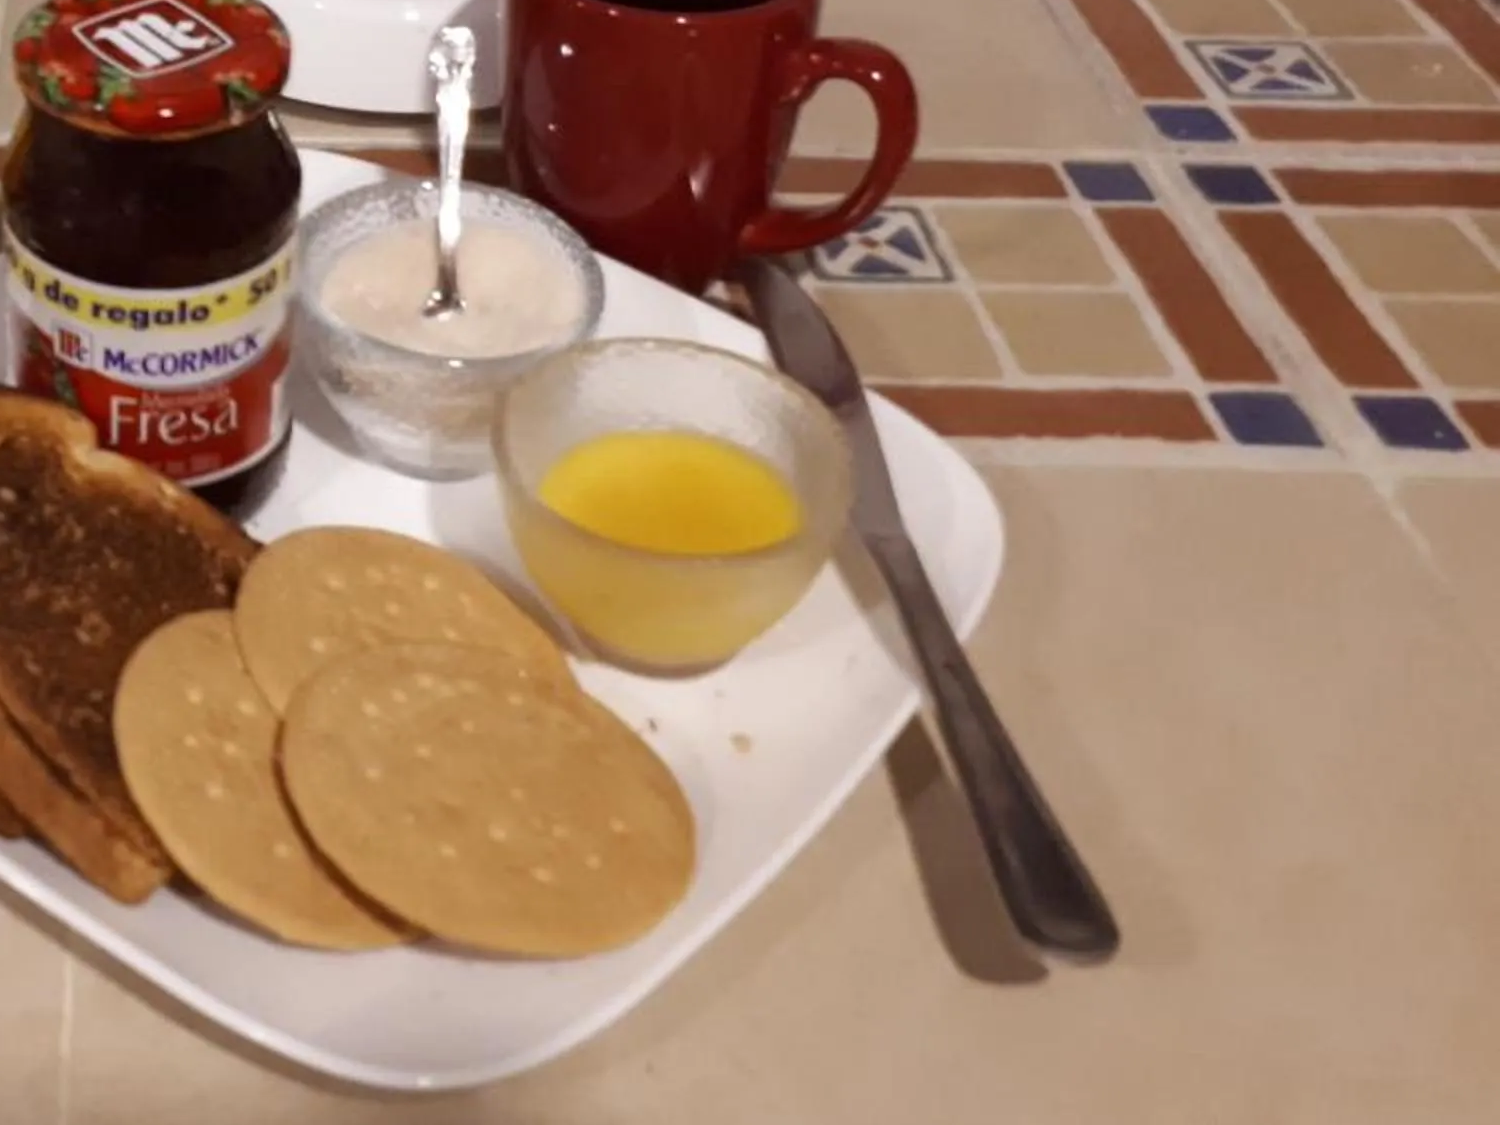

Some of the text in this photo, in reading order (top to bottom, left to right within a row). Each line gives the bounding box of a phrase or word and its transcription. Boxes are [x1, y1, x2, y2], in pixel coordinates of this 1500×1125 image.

[43, 279, 79, 312] de
[91, 299, 210, 331] regalo
[109, 394, 238, 445] Fresa
